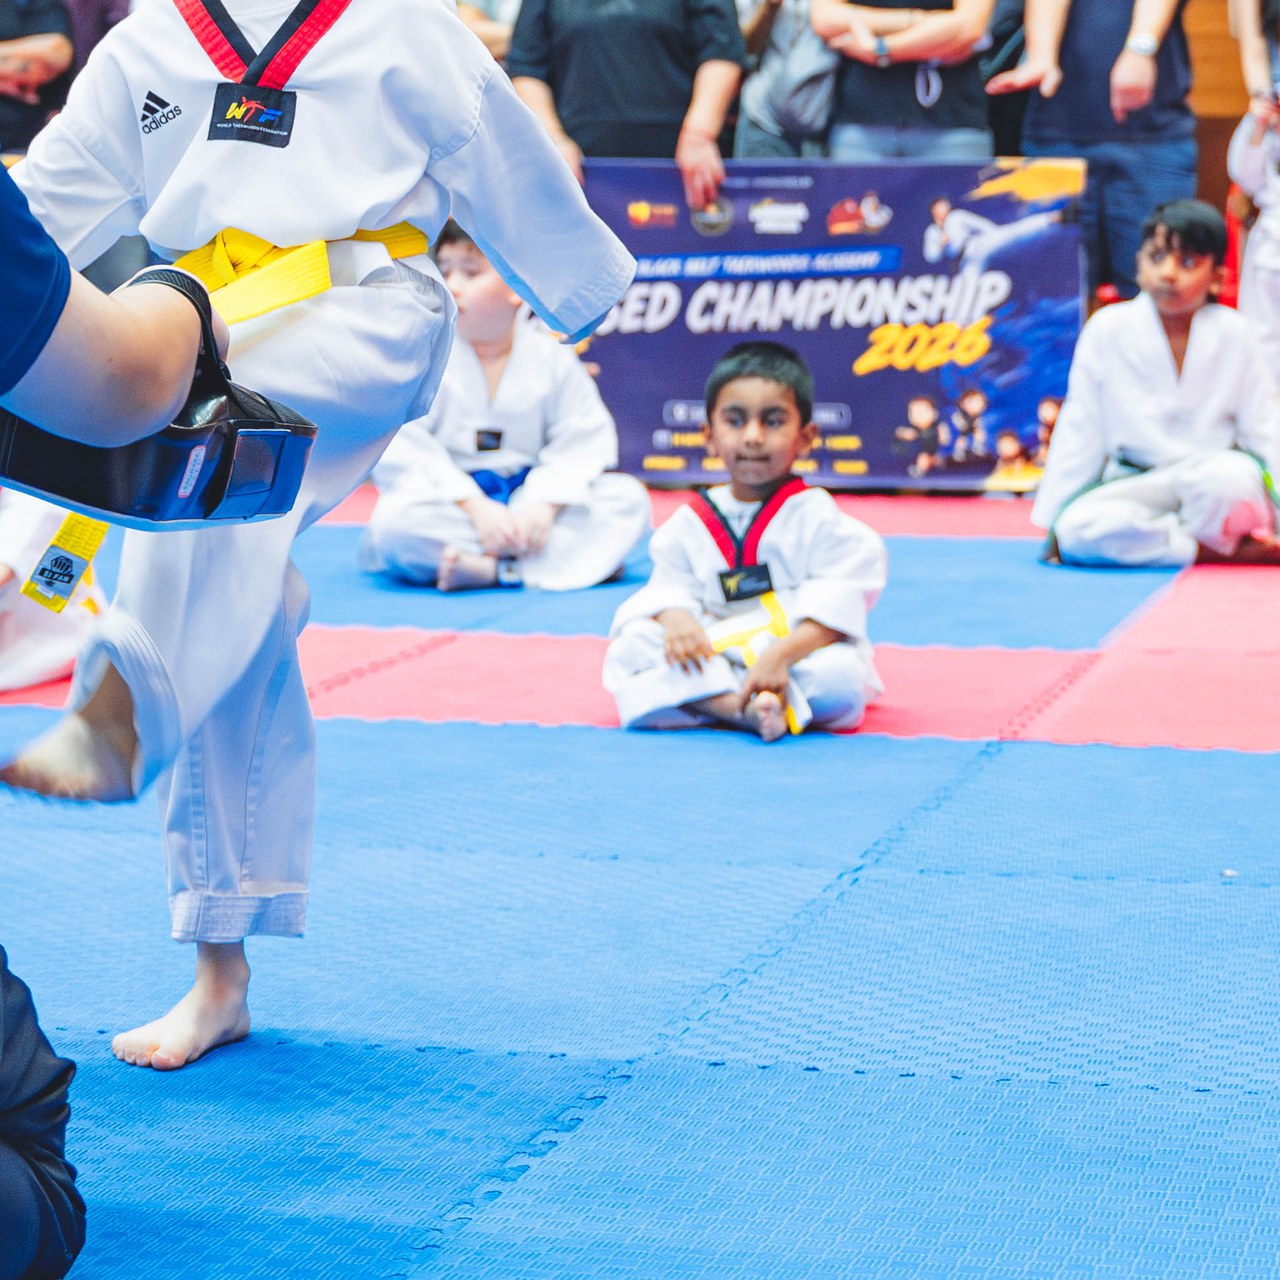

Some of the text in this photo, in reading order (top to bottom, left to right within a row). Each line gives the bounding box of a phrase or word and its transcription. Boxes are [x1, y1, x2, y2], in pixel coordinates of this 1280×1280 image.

[142, 105, 182, 135] adidas
[225, 96, 283, 123] WTF
[685, 272, 1011, 333] CHAMPIONSHIP
[852, 315, 994, 376] 2026
